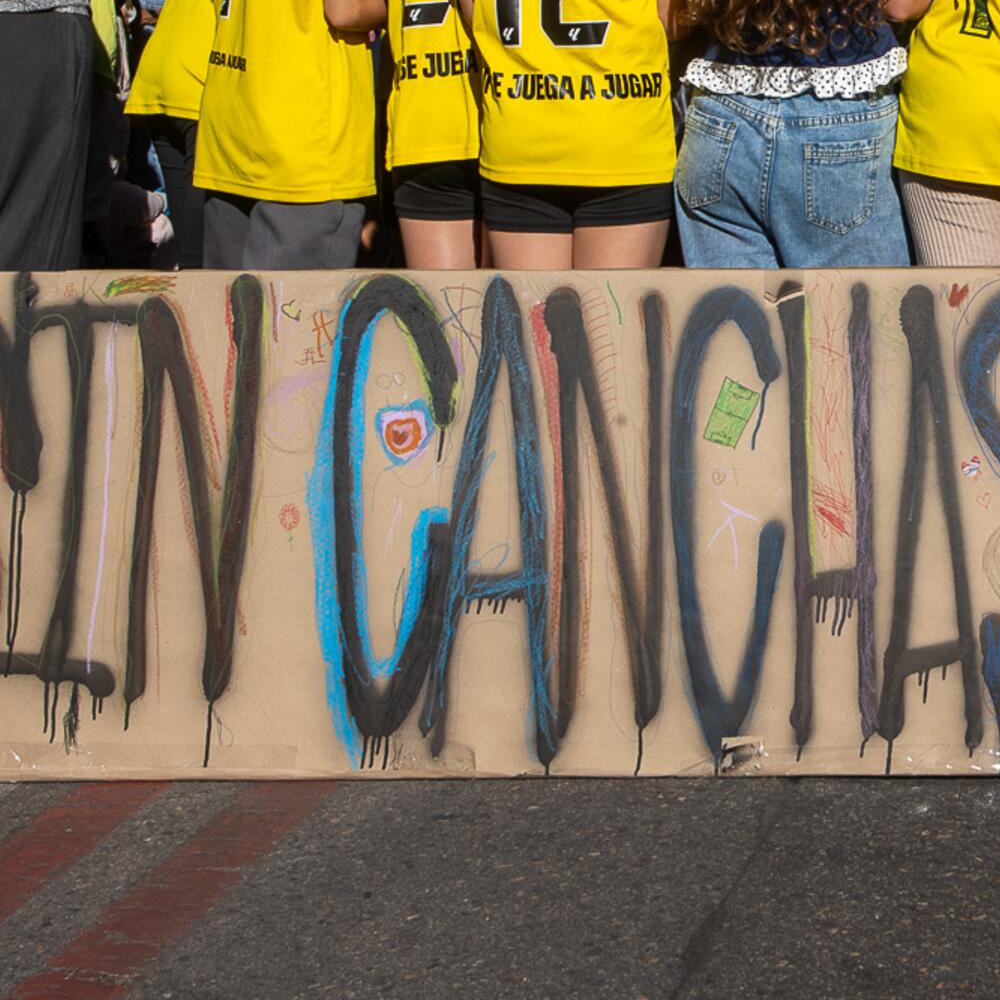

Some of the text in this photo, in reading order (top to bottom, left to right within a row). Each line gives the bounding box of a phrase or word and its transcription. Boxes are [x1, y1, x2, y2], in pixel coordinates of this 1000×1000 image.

[507, 73, 575, 101] JUEGA
[580, 75, 597, 101] A
[601, 72, 662, 99] JUGAR
[0, 270, 264, 704] IN
